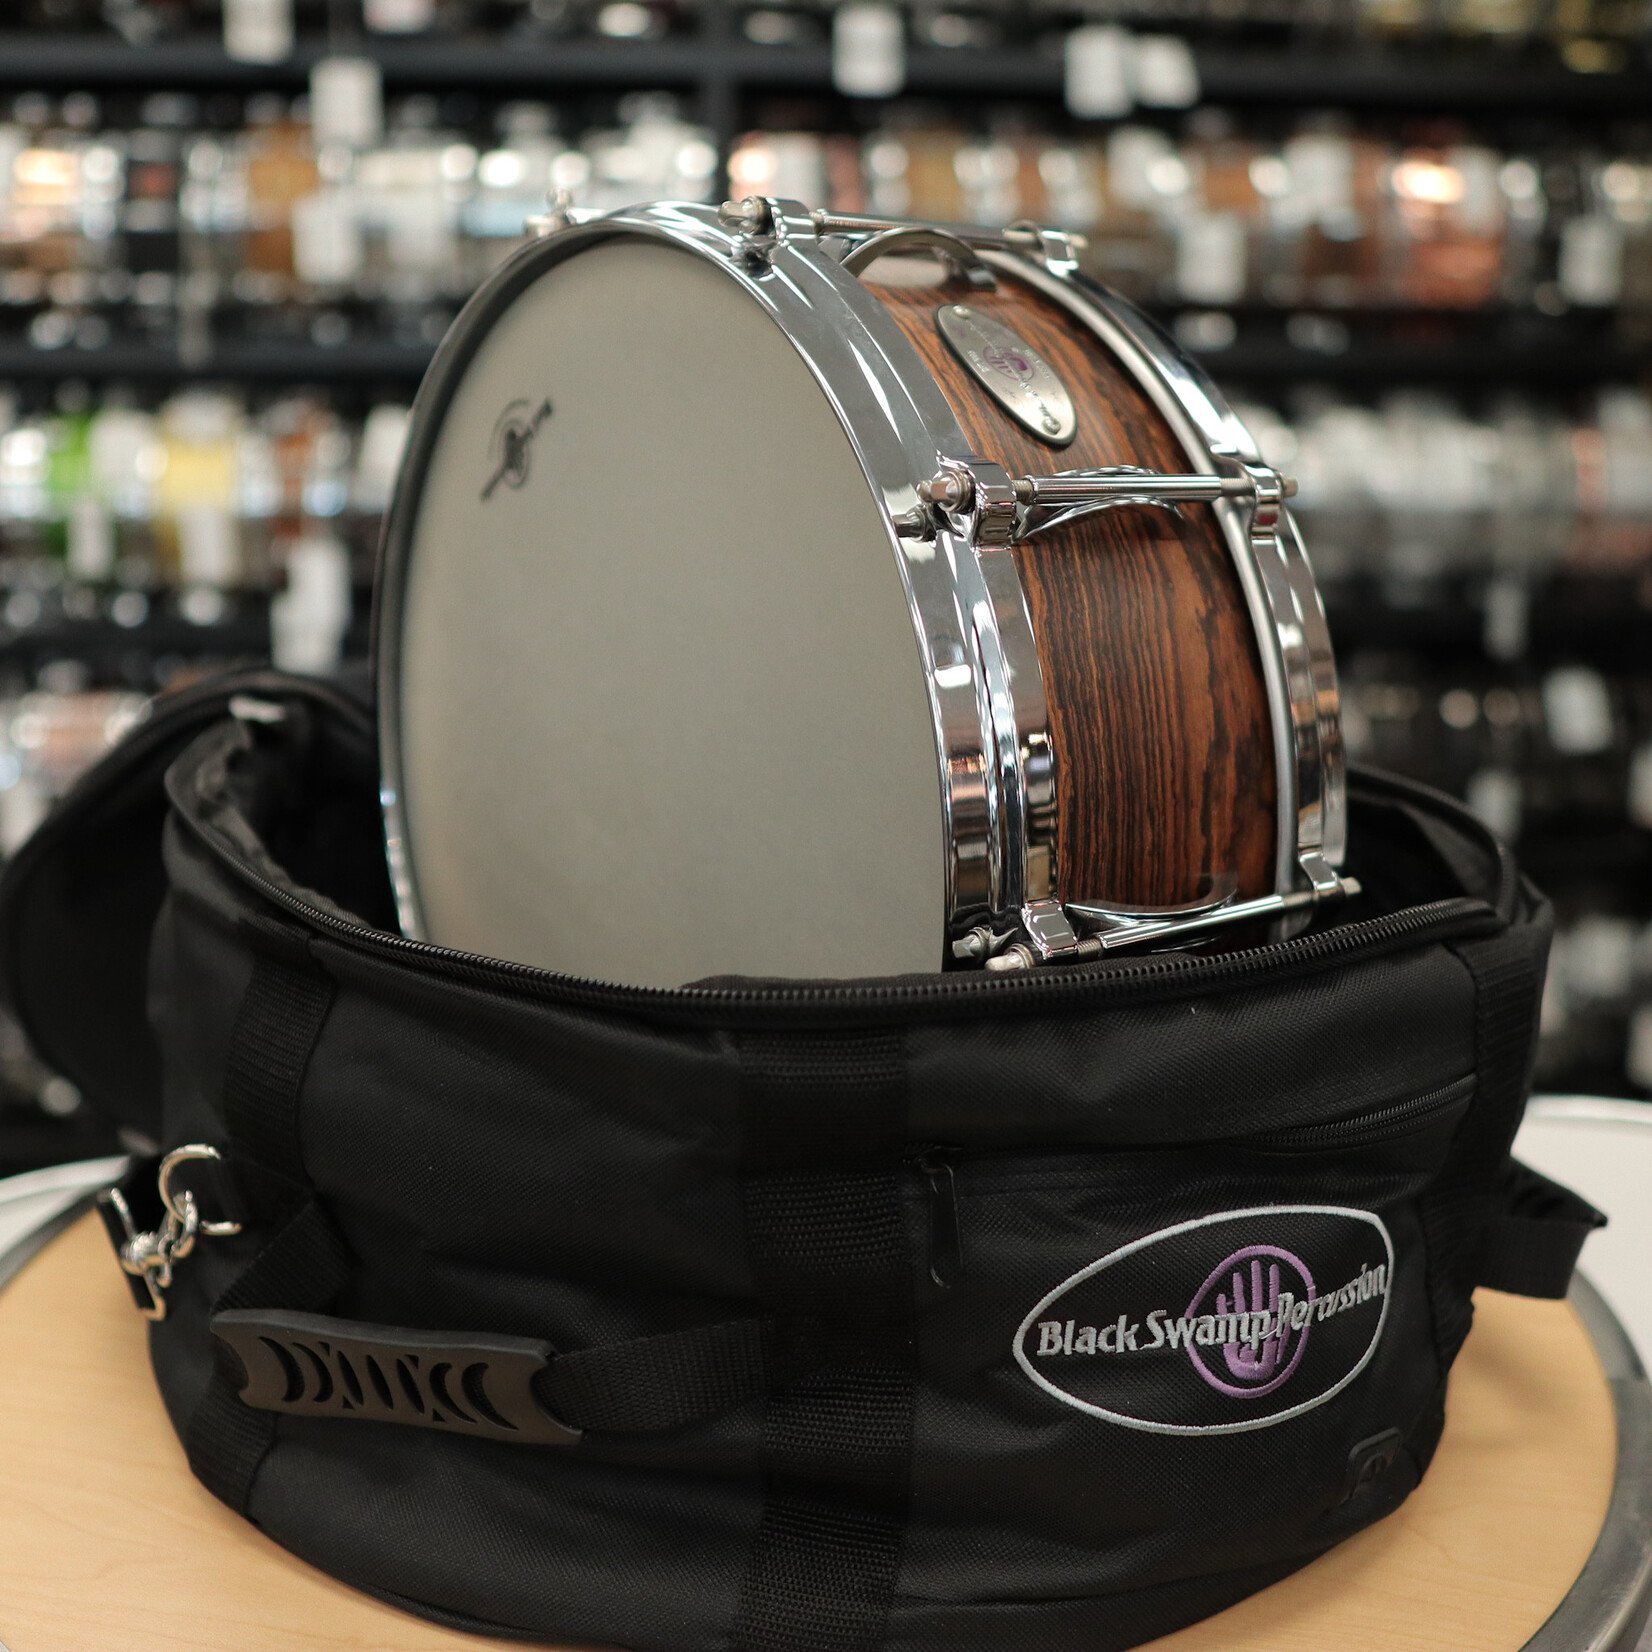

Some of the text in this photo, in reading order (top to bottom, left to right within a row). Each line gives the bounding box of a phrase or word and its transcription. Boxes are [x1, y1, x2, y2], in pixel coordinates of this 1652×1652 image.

[1036, 1262, 1386, 1356] Black Swamp Percussion
